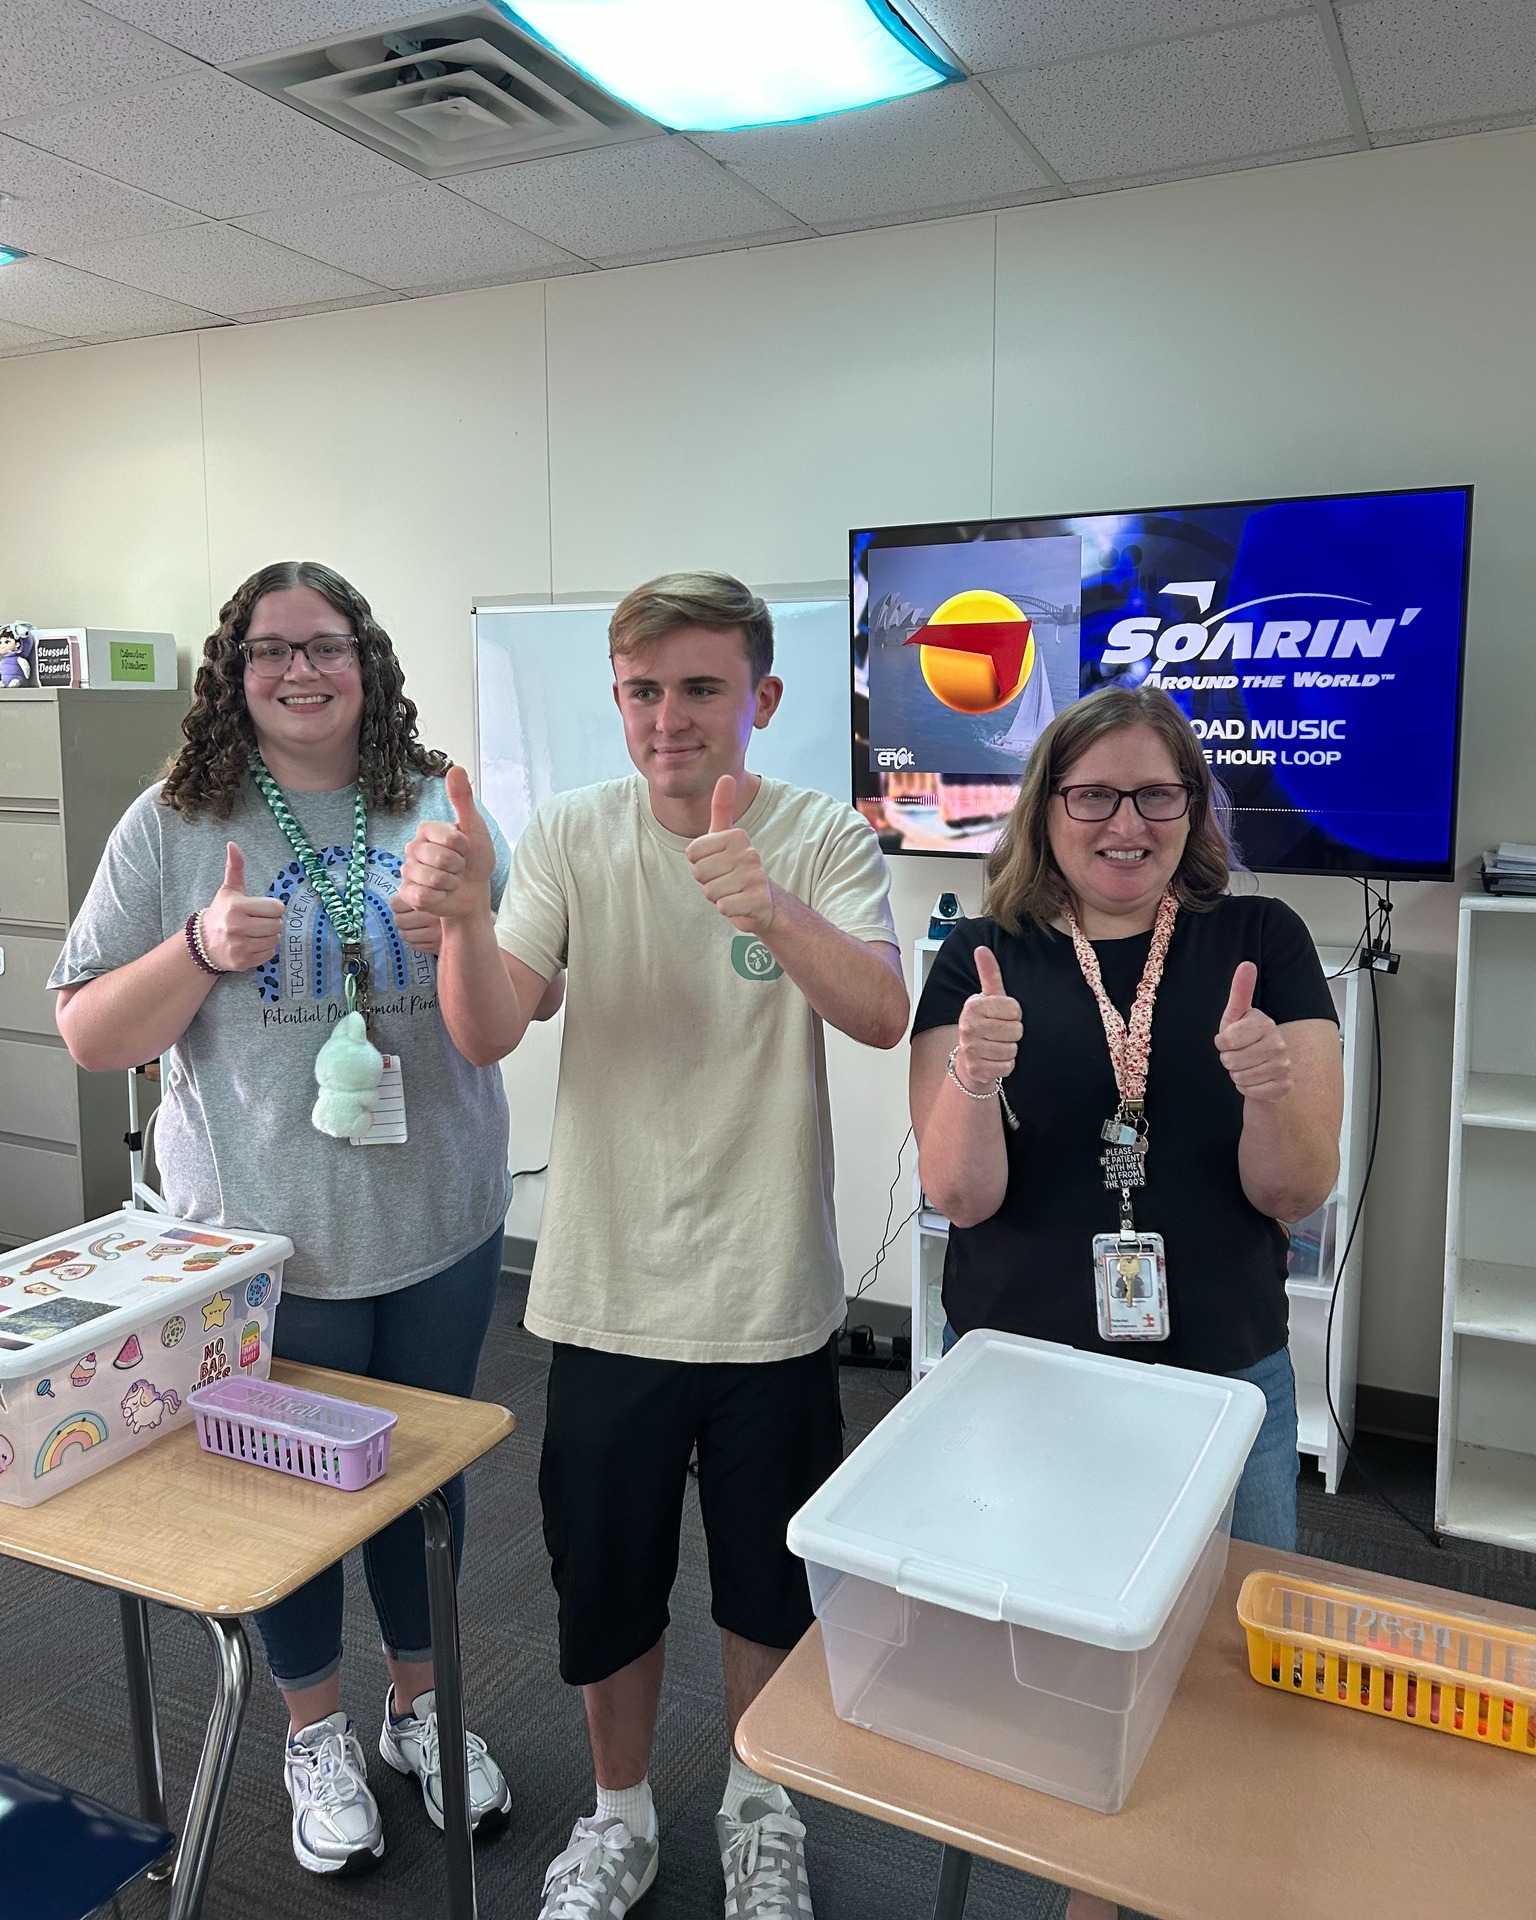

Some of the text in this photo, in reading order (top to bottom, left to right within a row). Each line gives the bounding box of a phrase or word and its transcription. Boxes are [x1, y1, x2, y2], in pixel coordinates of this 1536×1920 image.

[38, 645, 69, 657] Stressed
[39, 662, 70, 673] Desserts
[1242, 674, 1286, 688] THE
[1189, 719, 1347, 740] OAD MUSIC
[1216, 750, 1277, 765] HOUR
[1281, 750, 1342, 766] LOOP
[290, 935, 304, 998] TEACHER
[364, 871, 399, 895] OTIVAT
[413, 950, 430, 985] STEN
[263, 992, 438, 1027] Potential Devlment Pirat
[1106, 1147, 1132, 1156] PLEASE
[1100, 1153, 1140, 1165] BE PATIENT
[1106, 1162, 1138, 1172] WITH ME
[1118, 1170, 1140, 1179] FROM
[1104, 1180, 1119, 1189] THE
[204, 1337, 224, 1361] NO
[200, 1353, 227, 1381] BAD
